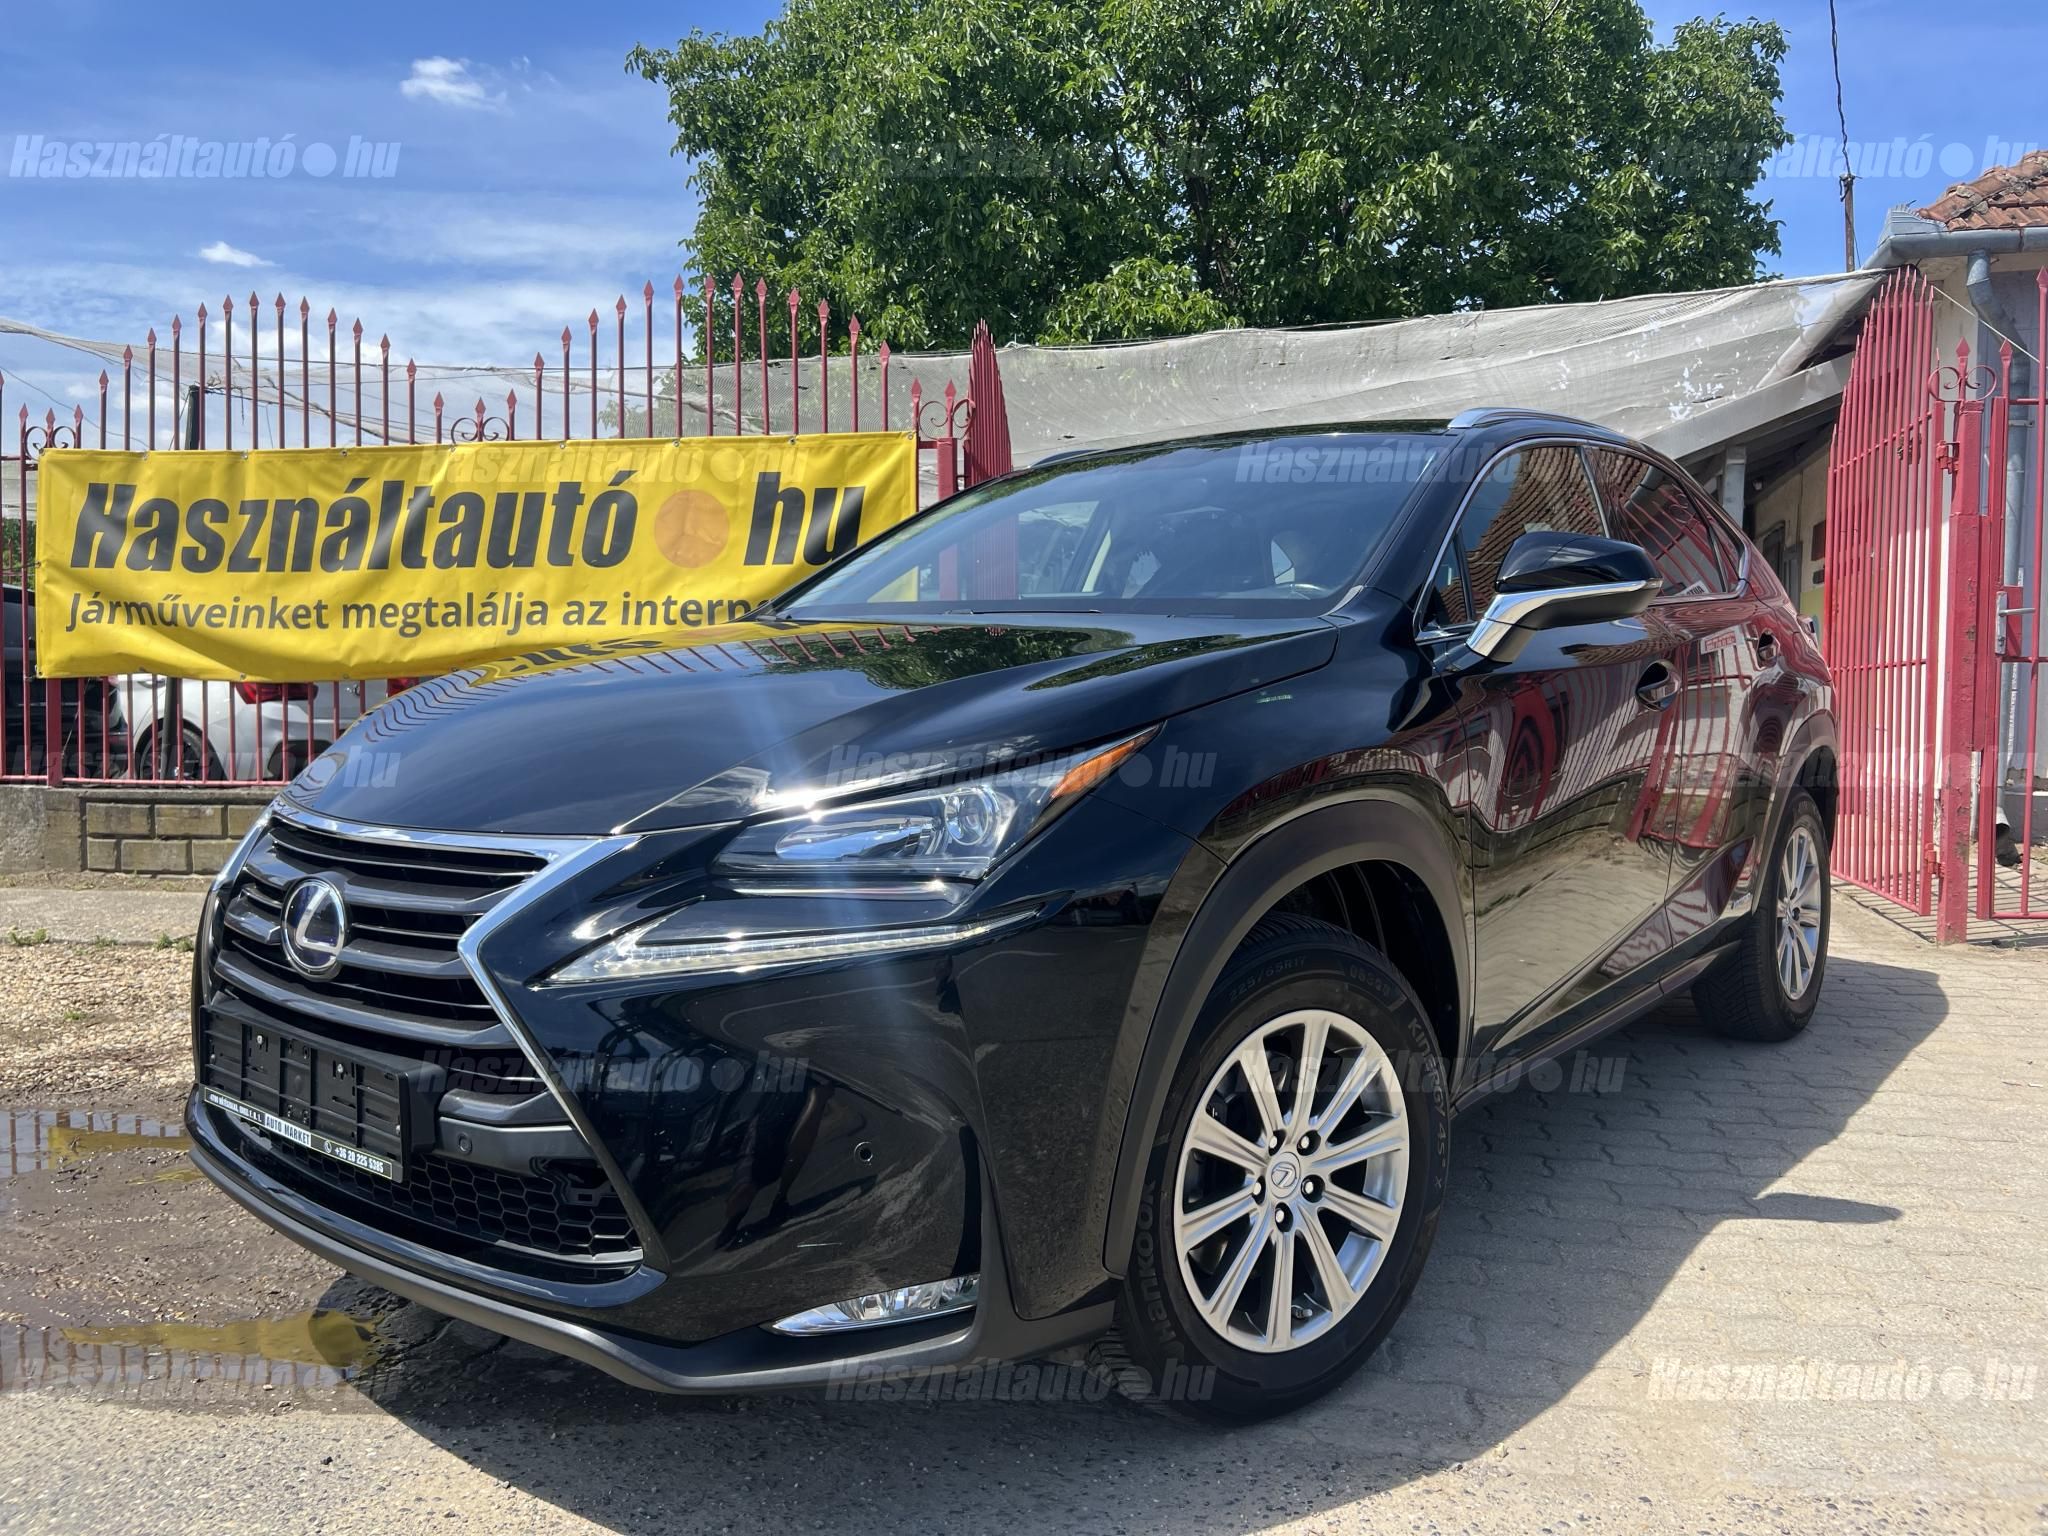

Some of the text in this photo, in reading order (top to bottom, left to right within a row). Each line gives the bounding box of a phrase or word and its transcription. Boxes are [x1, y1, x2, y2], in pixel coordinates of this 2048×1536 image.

[71, 470, 866, 573] Használtautó hu
[66, 591, 770, 638] Járműveinket megtalálja az intern
[266, 1115, 310, 1146] AUTO MARKET
